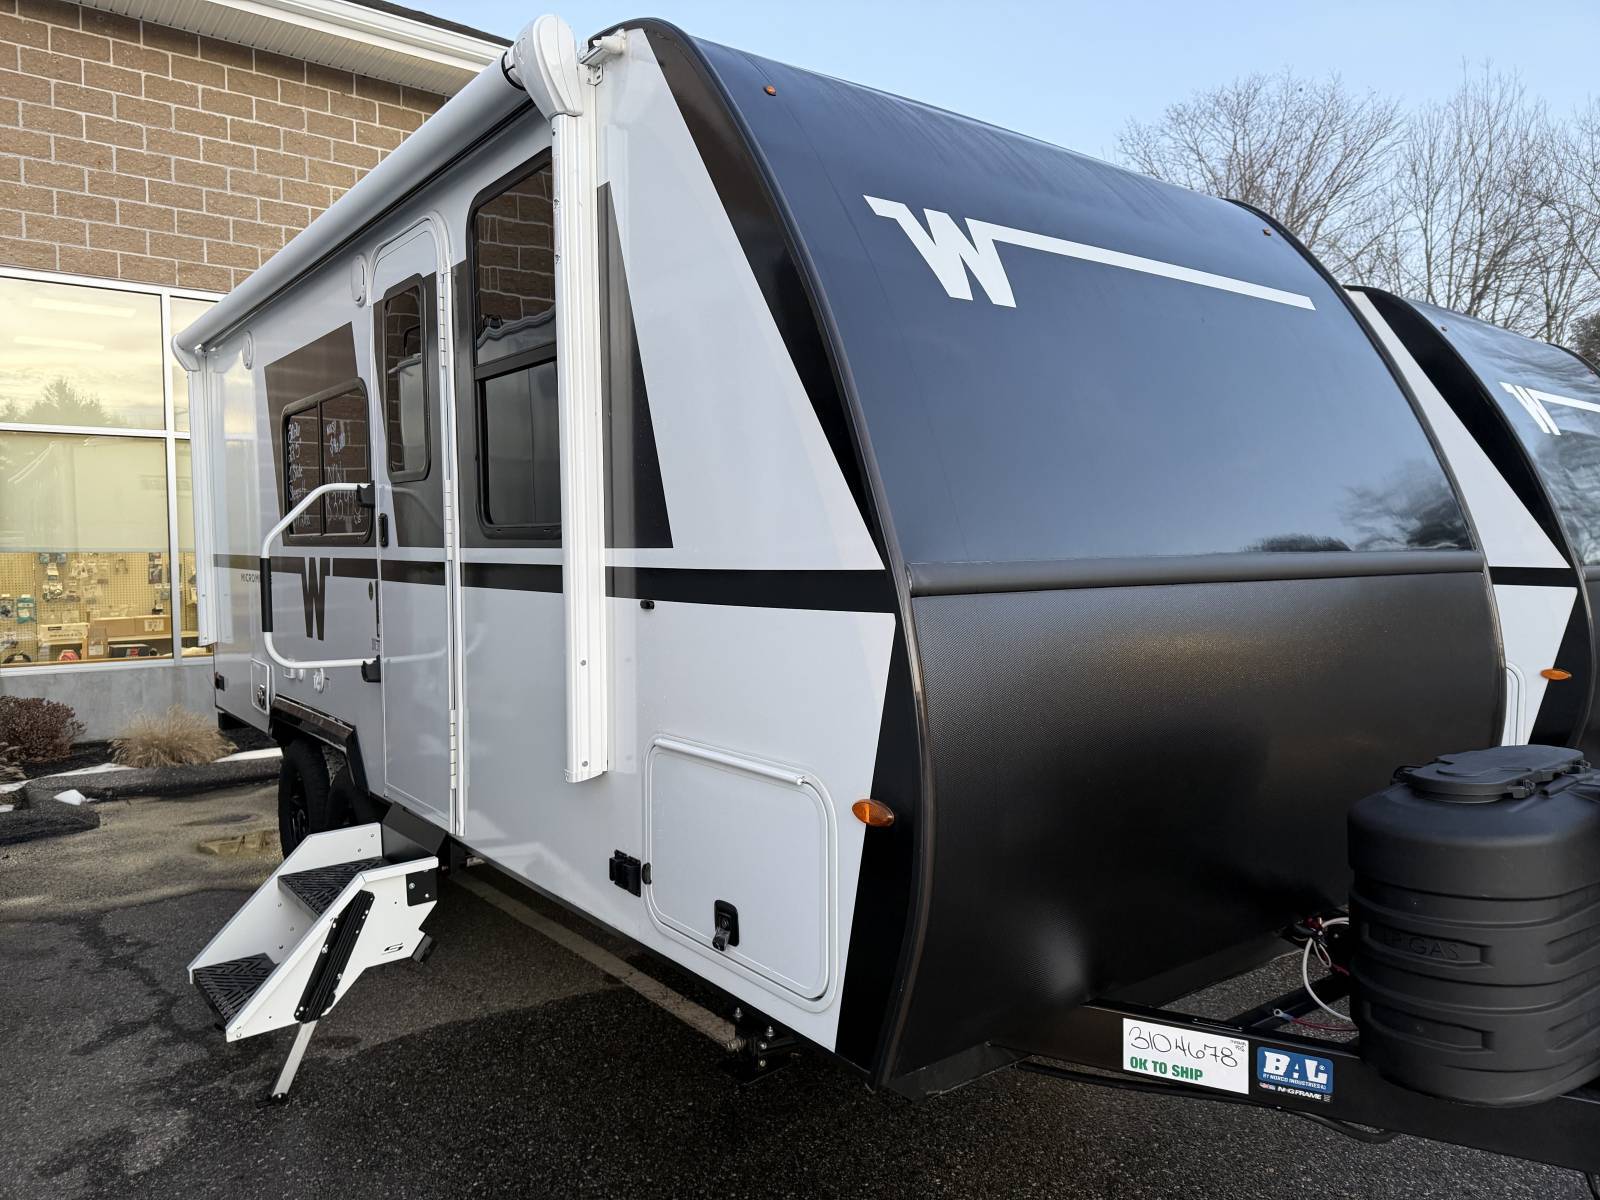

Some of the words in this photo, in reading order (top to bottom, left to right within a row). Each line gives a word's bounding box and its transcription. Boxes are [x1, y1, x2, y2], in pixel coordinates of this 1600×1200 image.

[1408, 935, 1462, 960] GAS
[1128, 1026, 1239, 1068] 3104678
[1130, 1056, 1148, 1071] OK
[1151, 1060, 1168, 1075] TO
[1172, 1064, 1204, 1081] SHIP
